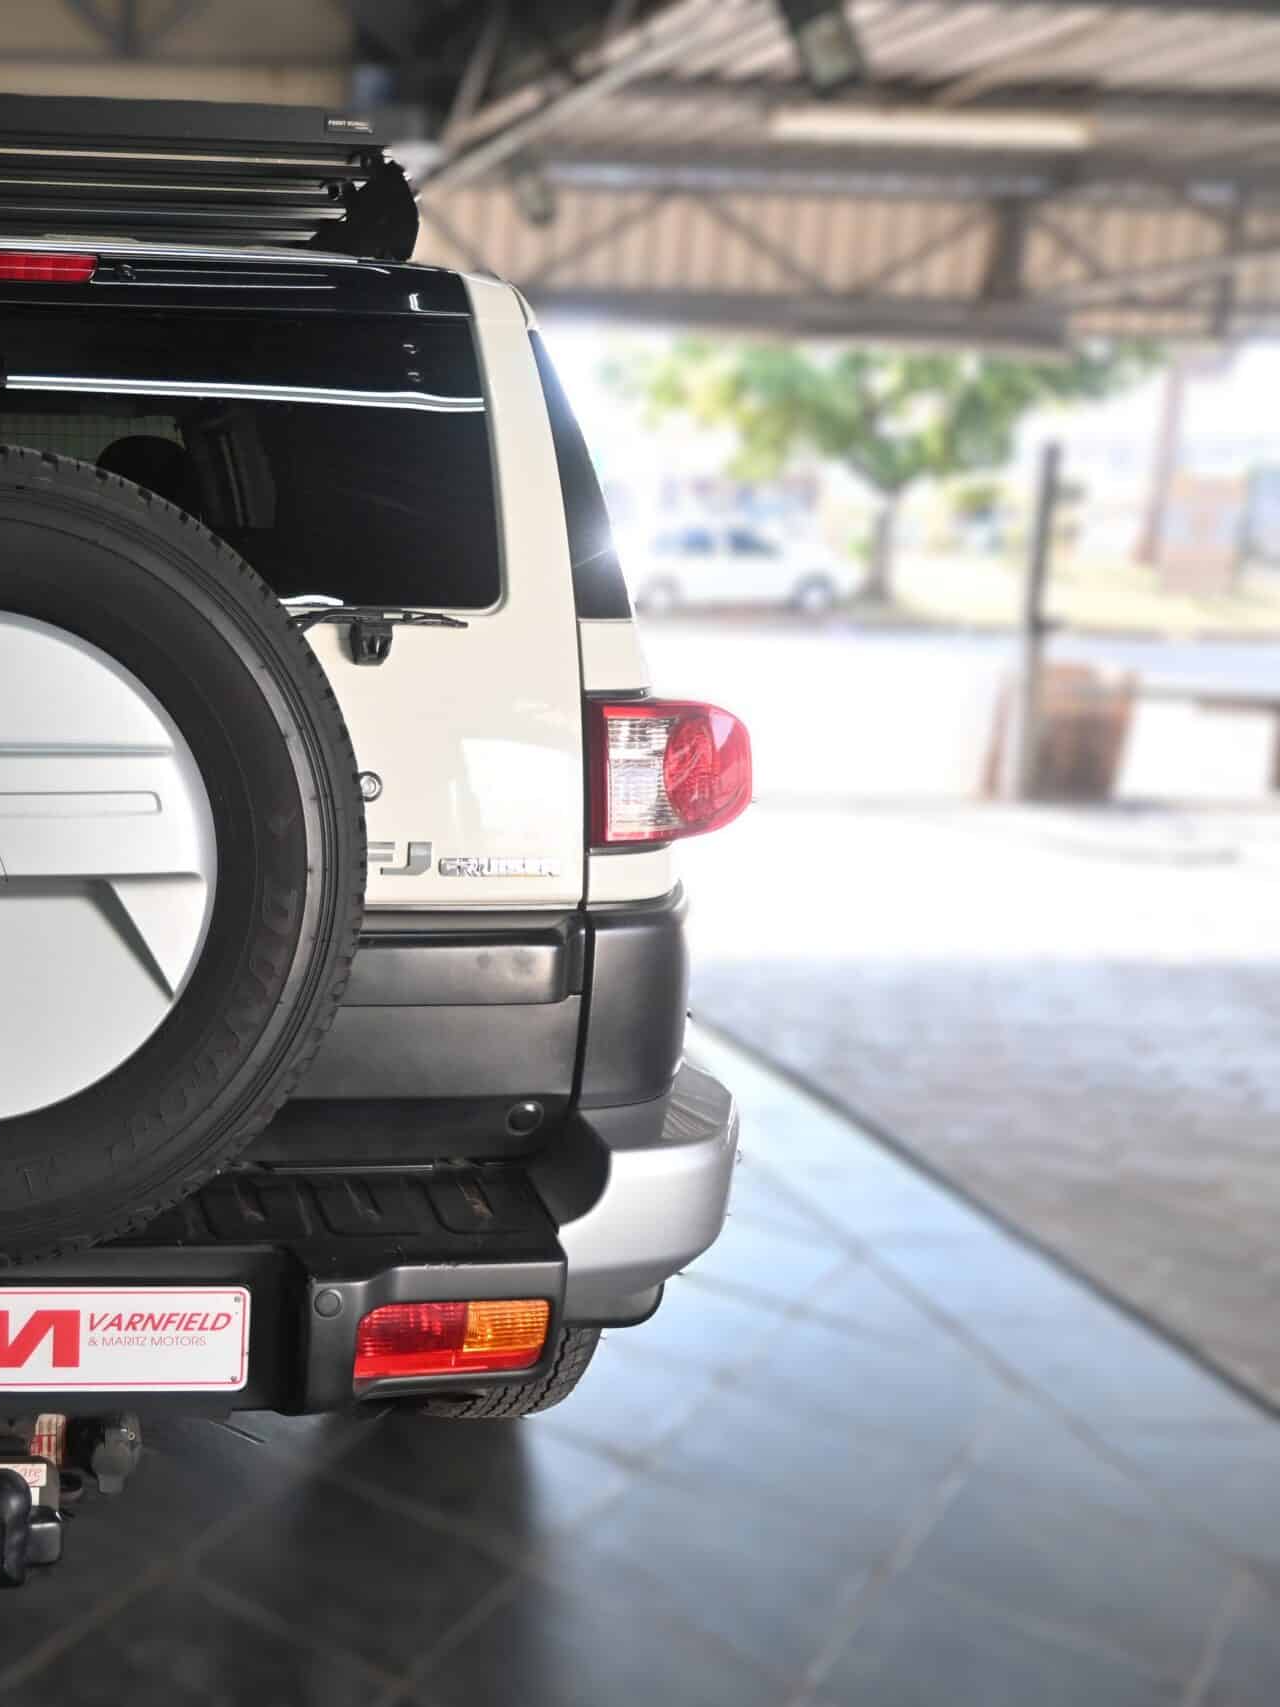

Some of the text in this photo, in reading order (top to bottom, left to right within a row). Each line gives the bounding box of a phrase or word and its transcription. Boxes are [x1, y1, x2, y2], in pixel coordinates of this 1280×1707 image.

[88, 1312, 232, 1332] VARNFIELD
[102, 1336, 147, 1346] MARITZ
[150, 1336, 207, 1346] MOTORS
